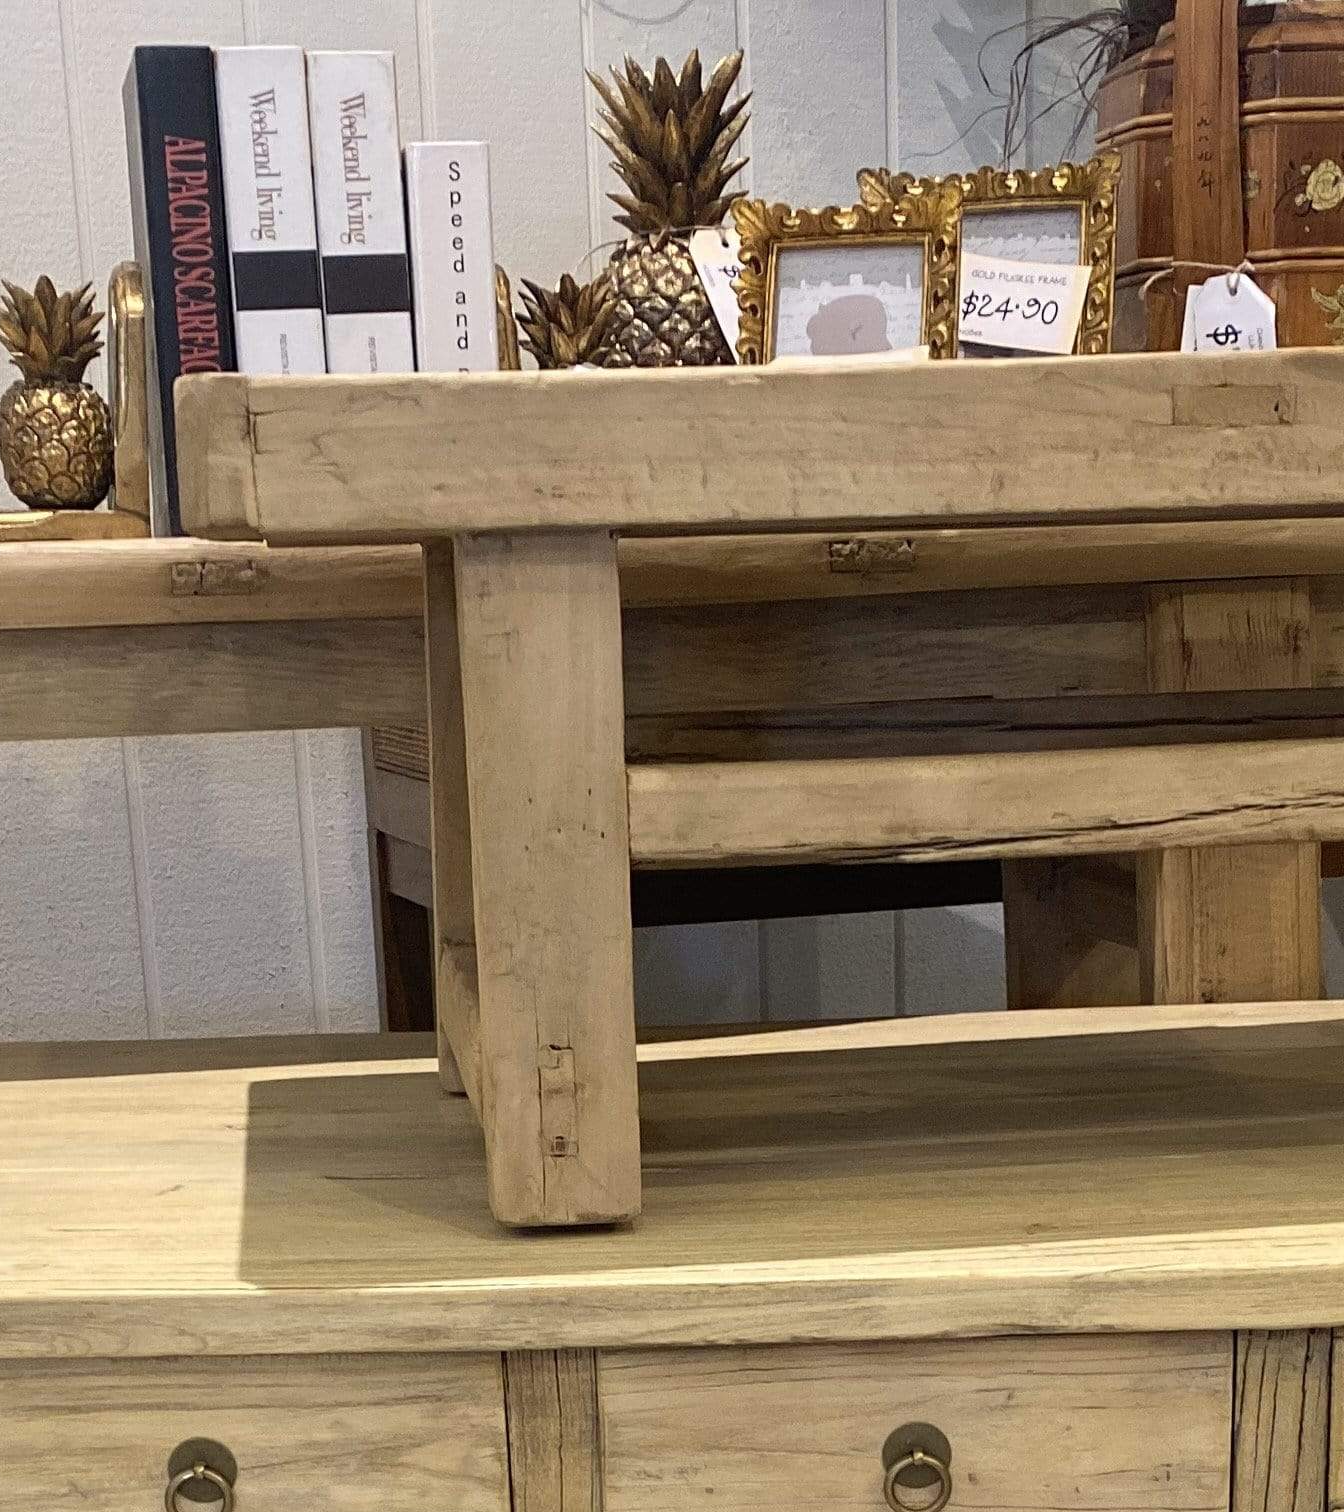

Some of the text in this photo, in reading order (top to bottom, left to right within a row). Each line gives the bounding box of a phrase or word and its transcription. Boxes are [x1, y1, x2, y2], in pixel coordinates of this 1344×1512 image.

[248, 88, 284, 241] Weekend living
[339, 92, 373, 244] Weekend living
[449, 161, 465, 274] Speed
[173, 266, 223, 375] SCARFAC
[455, 291, 469, 350] and
[972, 269, 995, 280] GOLD
[1038, 275, 1068, 287] FRAME
